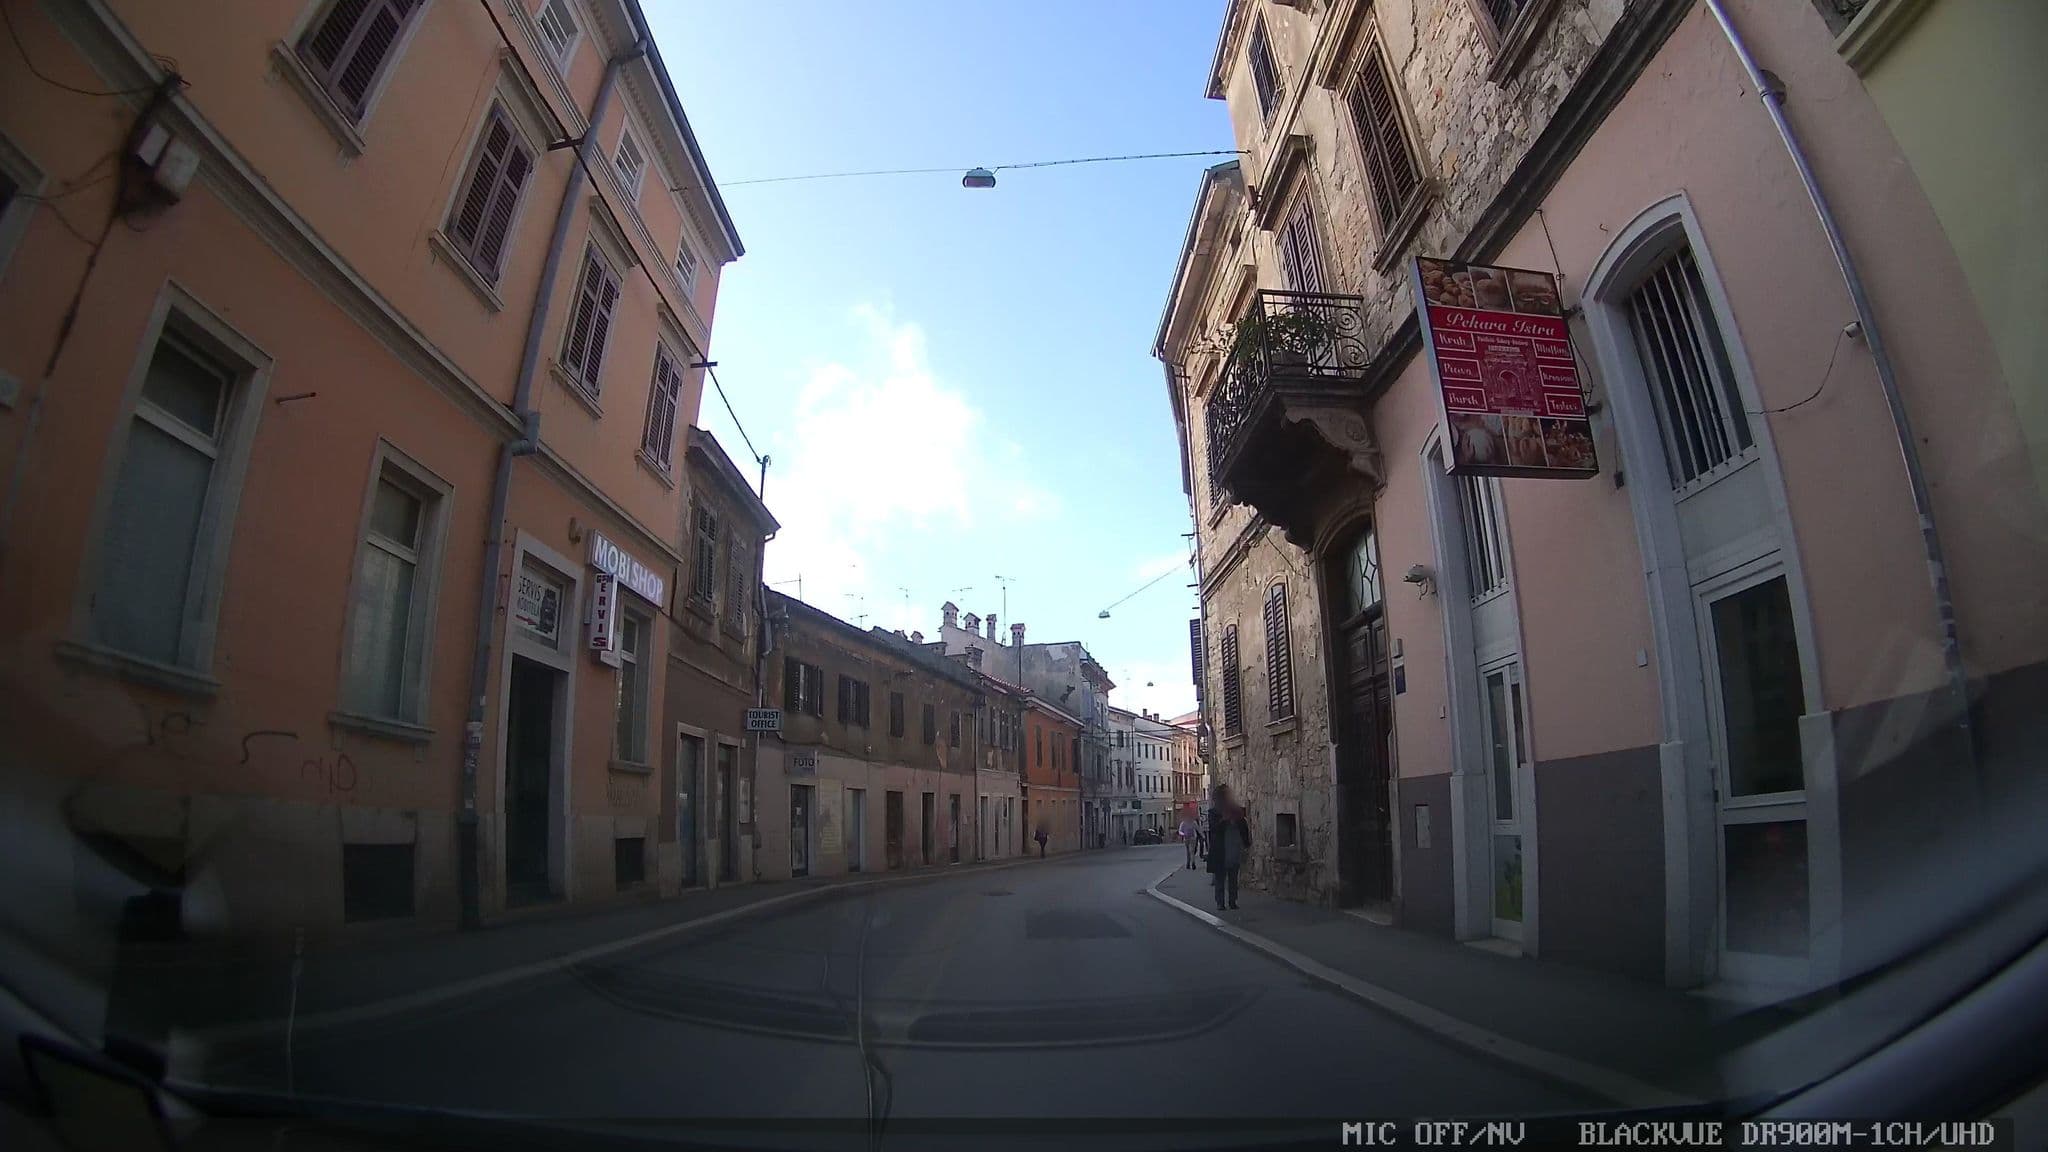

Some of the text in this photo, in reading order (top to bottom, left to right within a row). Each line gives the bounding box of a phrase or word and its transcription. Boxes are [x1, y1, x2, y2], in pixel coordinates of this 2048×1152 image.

[1513, 320, 1556, 336] Istra
[594, 535, 664, 604] MOBI SHOP
[518, 575, 541, 602] SERVIS
[749, 711, 779, 720] TOURIST
[751, 720, 777, 729] OFFICE
[793, 758, 815, 767] FOTO
